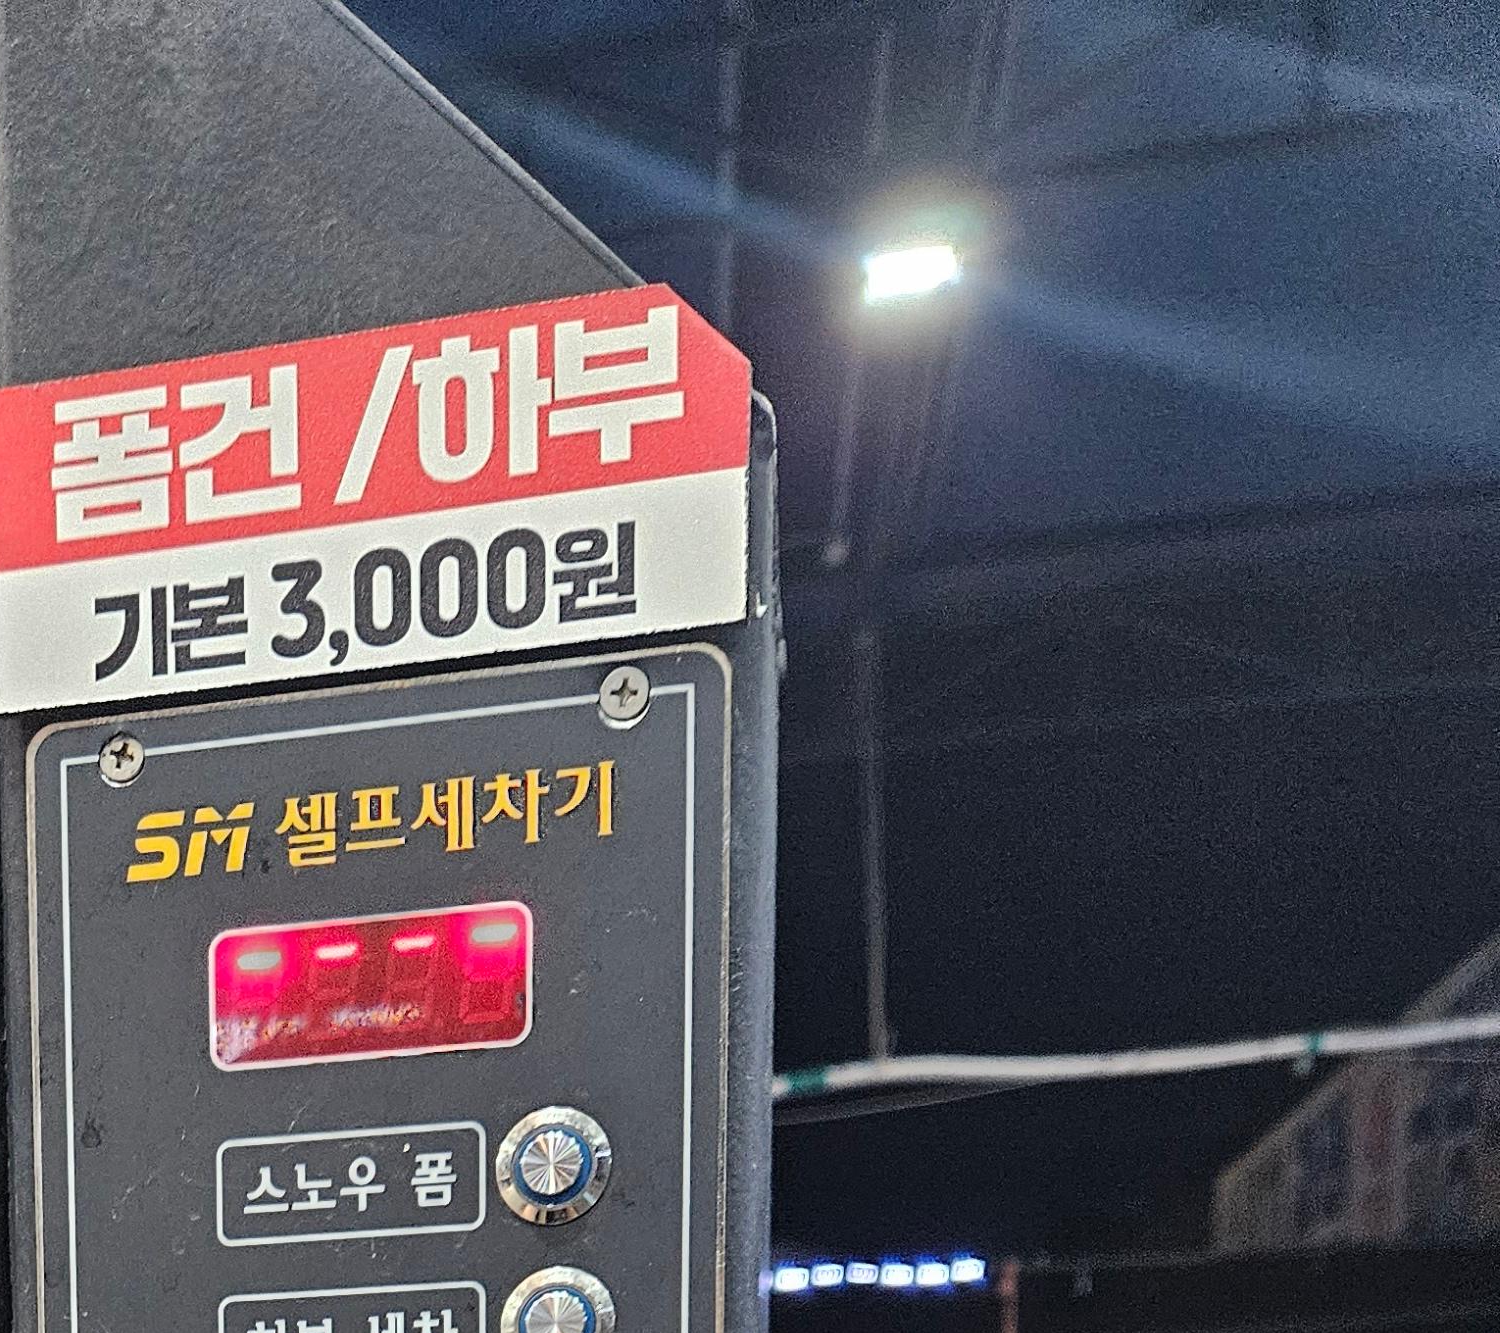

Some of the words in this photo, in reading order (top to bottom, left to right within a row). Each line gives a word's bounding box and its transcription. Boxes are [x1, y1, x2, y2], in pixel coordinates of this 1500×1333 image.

[52, 364, 302, 542] 폼건
[94, 574, 247, 681] 기본
[270, 520, 637, 666] 3,000원
[126, 801, 253, 882] SM
[275, 760, 616, 865] 셀프세차기
[243, 1156, 386, 1214] 스노우
[411, 1151, 457, 1207] 폼
